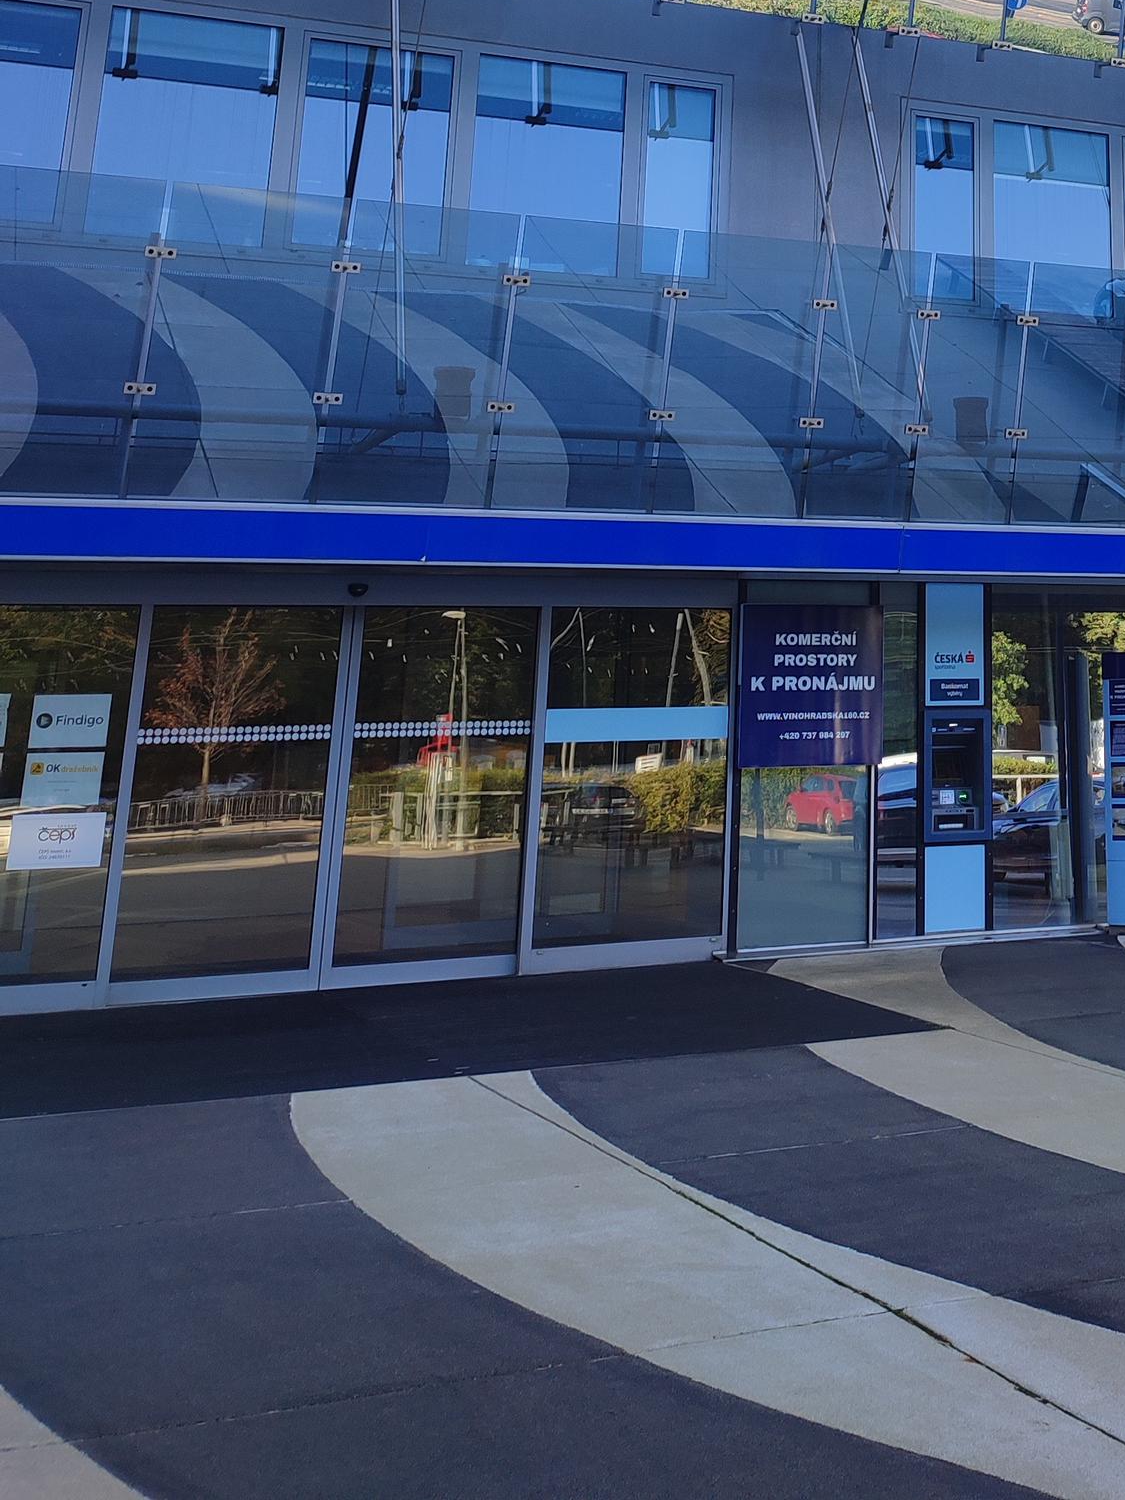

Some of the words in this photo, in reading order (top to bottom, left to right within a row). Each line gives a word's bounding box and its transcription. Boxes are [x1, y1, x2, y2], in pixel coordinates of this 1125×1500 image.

[775, 630, 857, 646] KOMERČNÍ
[774, 654, 858, 667] PROSTORY
[934, 651, 964, 664] ČESKÁ
[750, 676, 766, 692] K
[771, 672, 876, 692] PRONÁJMU
[55, 714, 104, 728] Findigo
[802, 731, 817, 740] 737
[46, 763, 60, 773] OK
